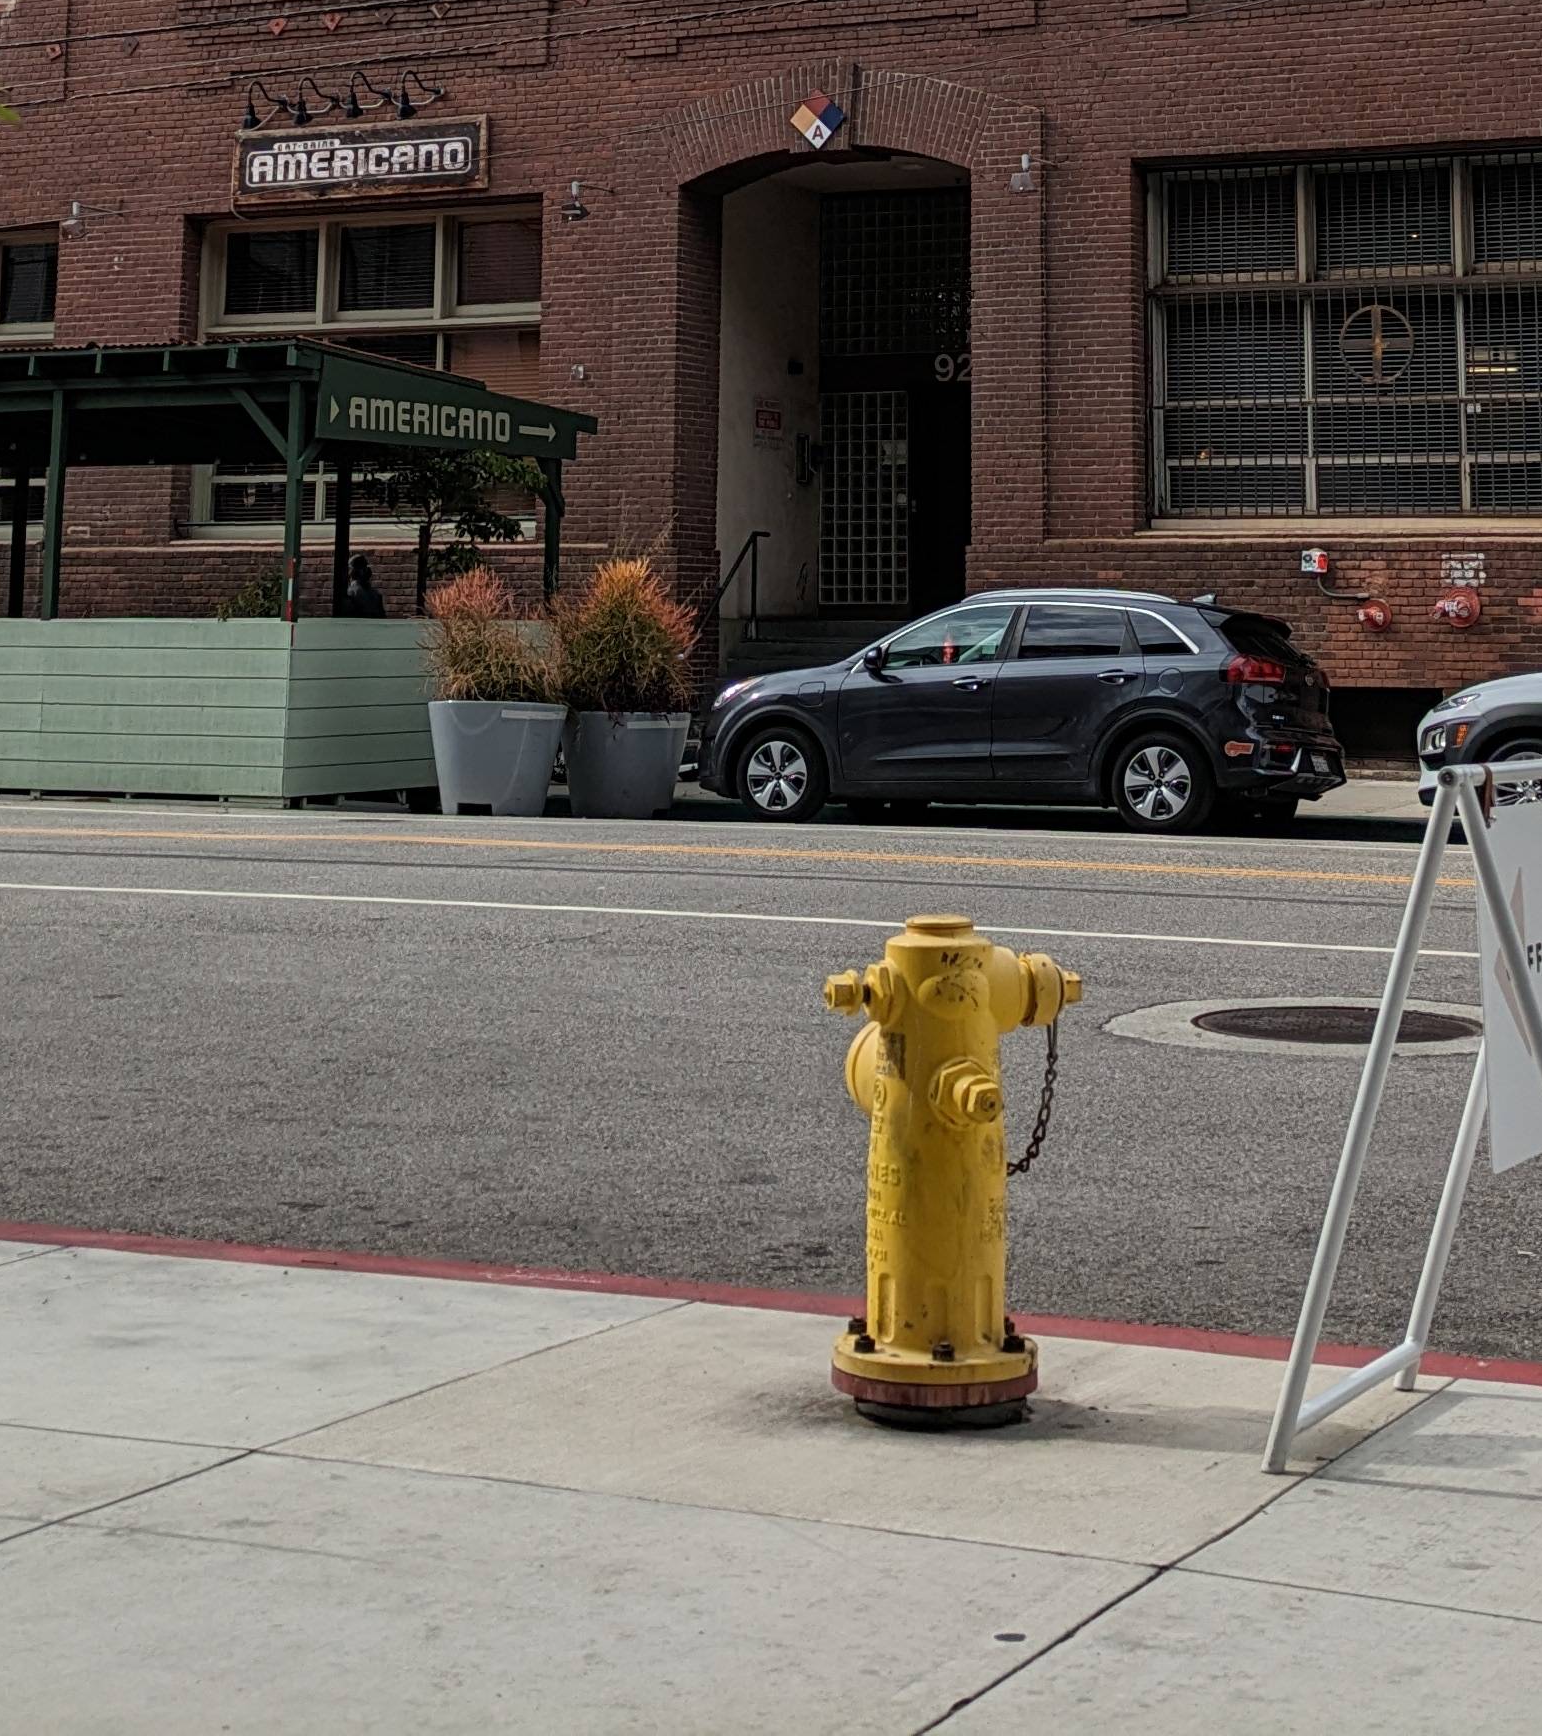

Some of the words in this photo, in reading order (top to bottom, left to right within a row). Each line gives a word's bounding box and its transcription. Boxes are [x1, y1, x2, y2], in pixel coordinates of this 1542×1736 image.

[811, 124, 825, 141] A
[251, 141, 465, 183] AMERICANO
[348, 395, 511, 444] AMERICANO
